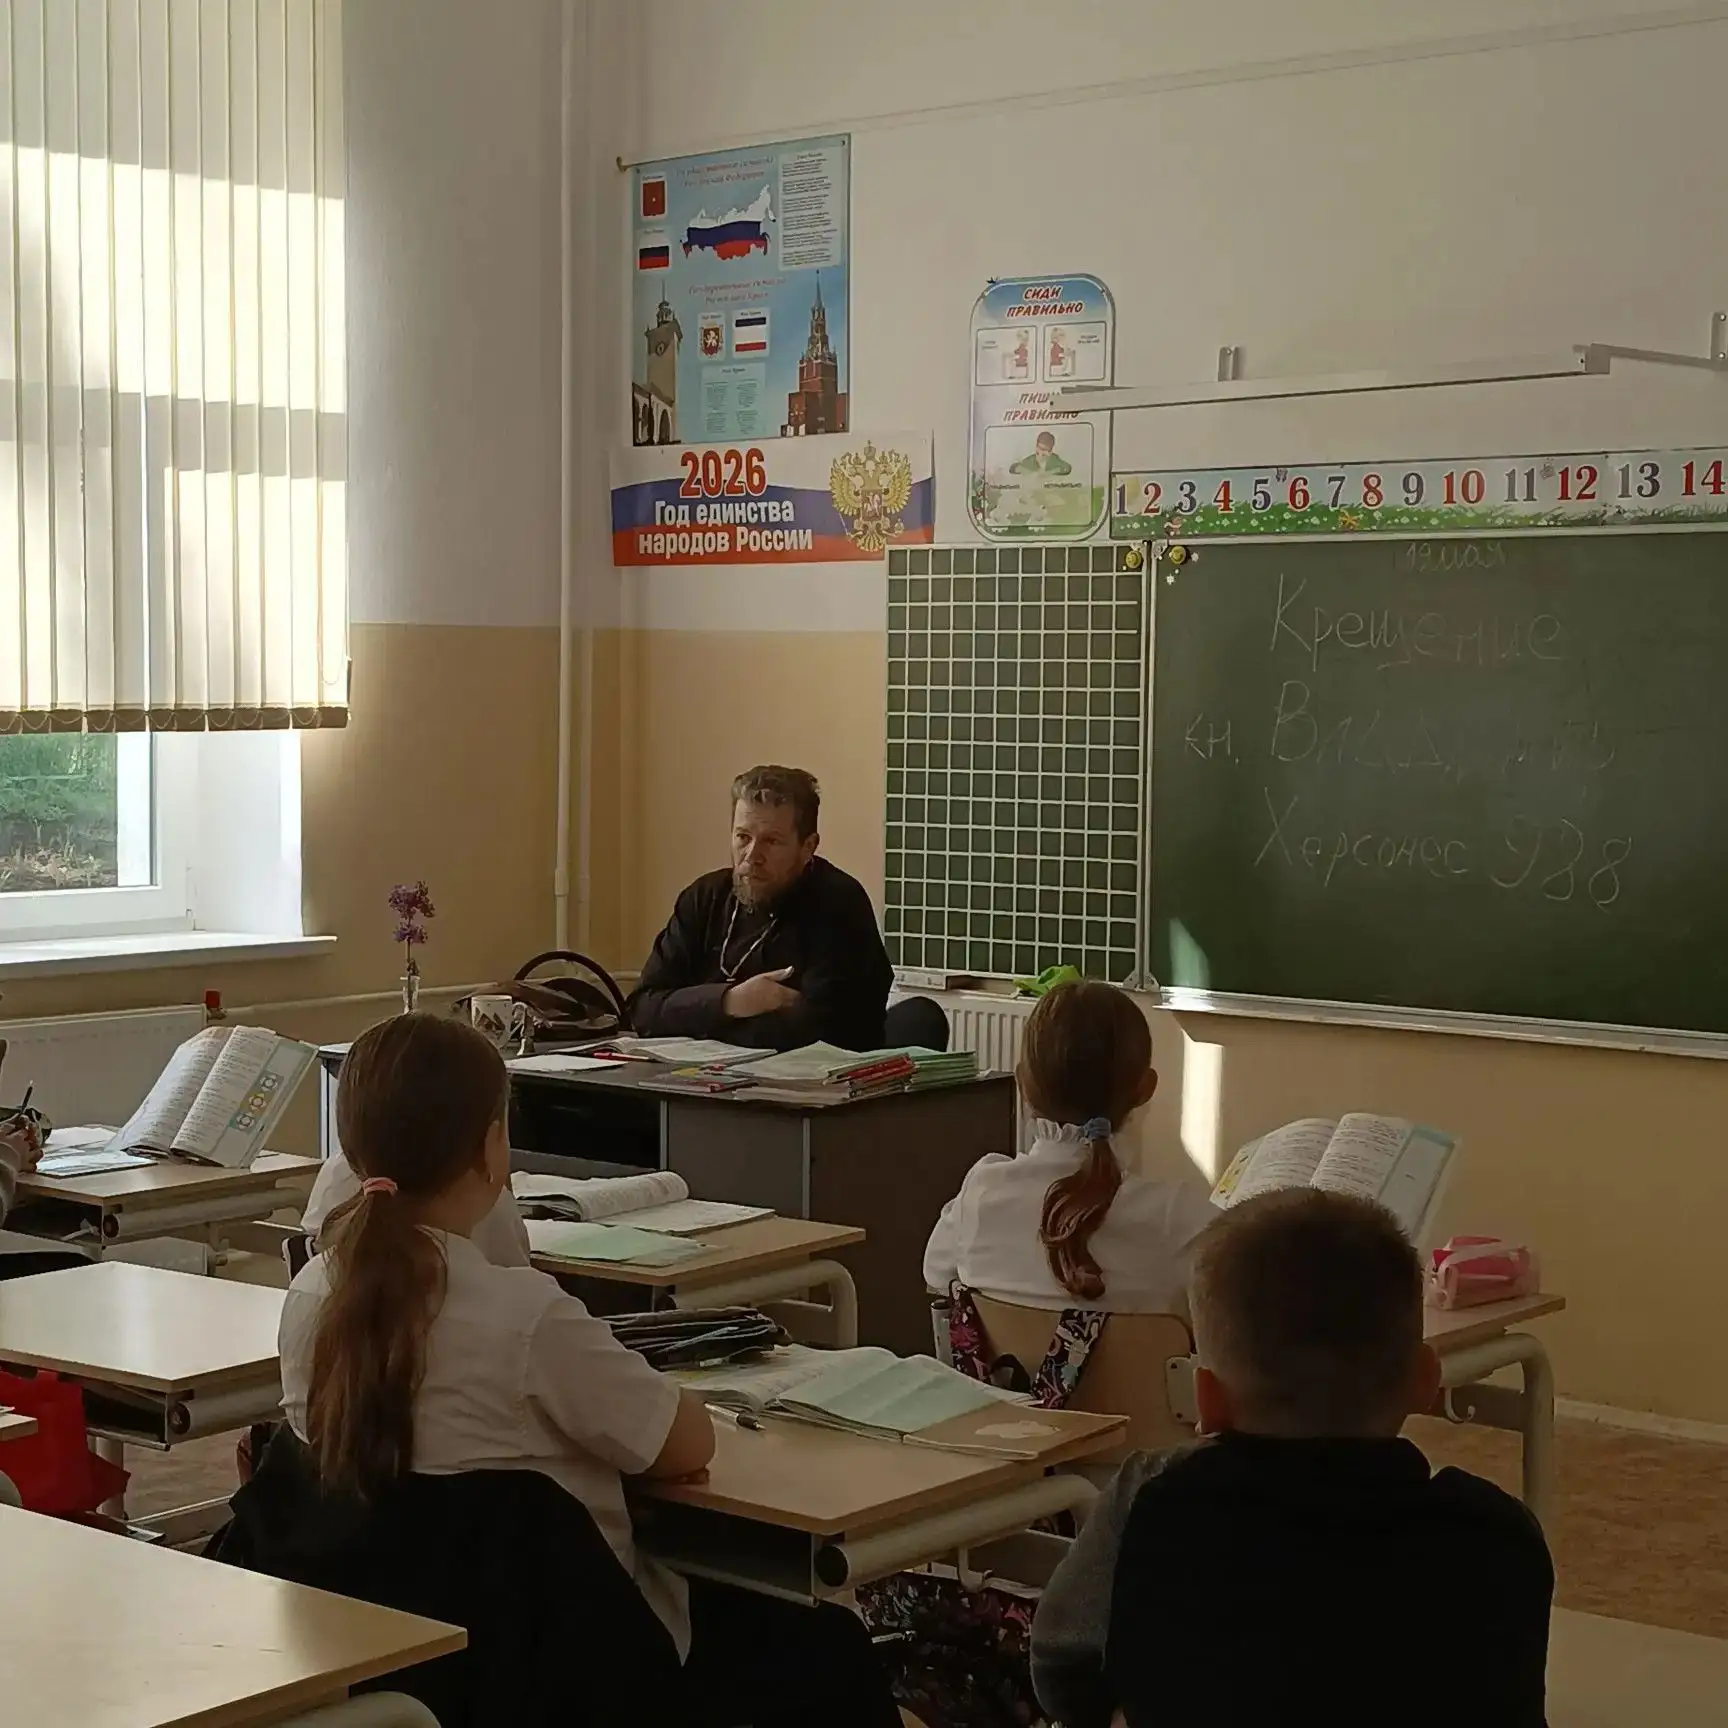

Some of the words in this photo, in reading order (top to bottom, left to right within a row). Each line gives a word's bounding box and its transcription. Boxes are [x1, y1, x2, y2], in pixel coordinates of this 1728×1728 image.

[1024, 286, 1061, 300] СИДИ
[1007, 302, 1083, 318] ПРАВИЛЬНО
[1018, 391, 1060, 405] ПИШ
[680, 448, 767, 498] 2026
[1115, 483, 1128, 515] 1
[1143, 482, 1162, 514] 2
[1177, 481, 1197, 513] 3
[1213, 480, 1234, 512] 4
[1251, 477, 1272, 511] 5
[1289, 476, 1310, 510] 6
[1327, 475, 1346, 508] 7
[1362, 474, 1383, 507] 8
[1402, 472, 1424, 505] 9
[1443, 470, 1485, 504] 10
[1504, 468, 1537, 502] 11
[1557, 465, 1598, 500] 12
[1617, 463, 1661, 498] 13
[1681, 460, 1726, 496] 14
[655, 501, 692, 527] Год
[696, 500, 795, 525] единства
[638, 528, 730, 559] народов
[736, 528, 812, 552] России
